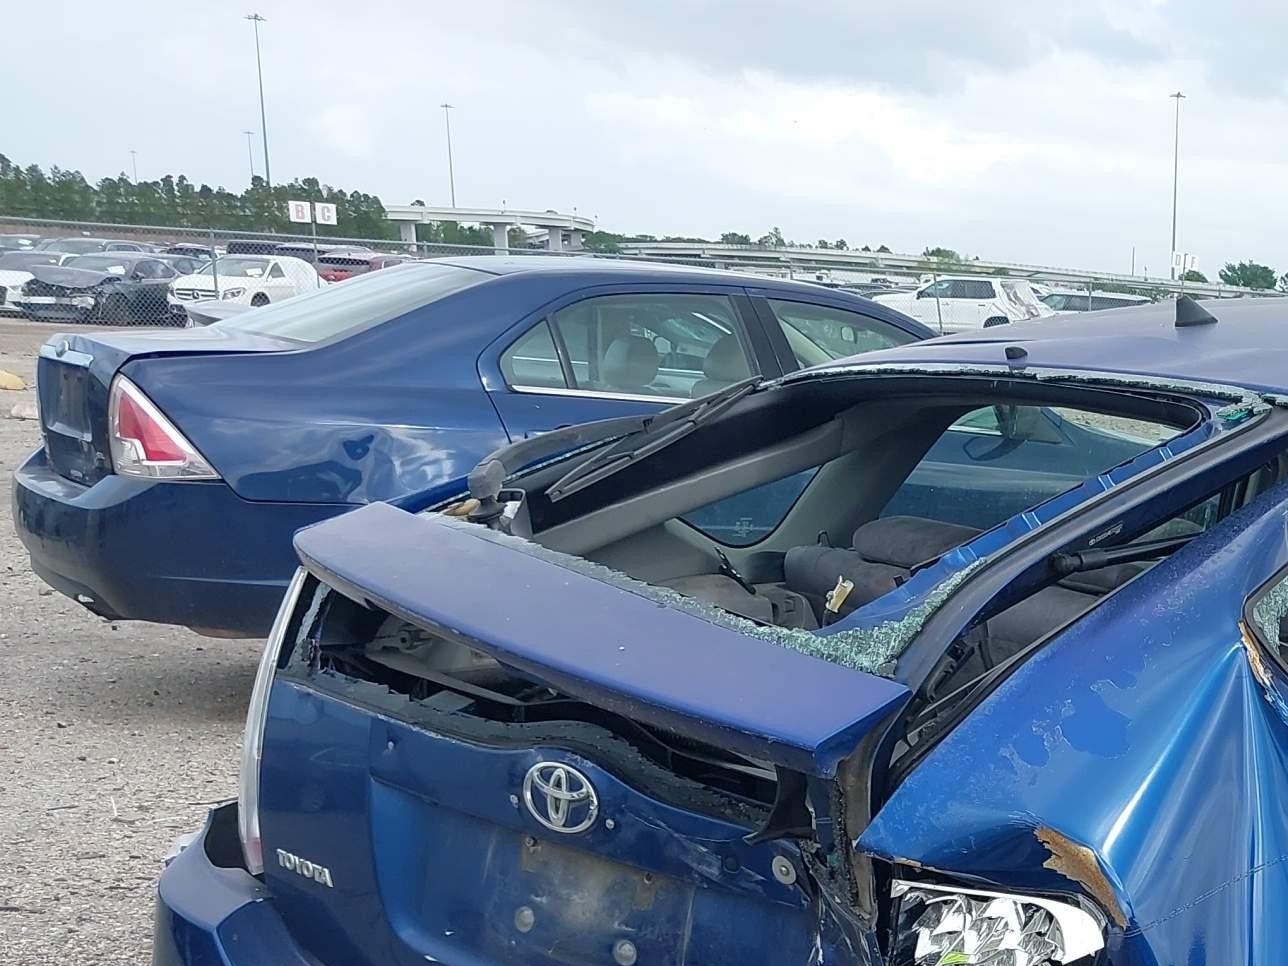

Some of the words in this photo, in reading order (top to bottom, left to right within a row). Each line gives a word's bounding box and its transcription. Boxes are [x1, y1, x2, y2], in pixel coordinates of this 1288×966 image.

[295, 204, 305, 219] B
[322, 206, 331, 221] C
[276, 848, 334, 888] TOYOTA
